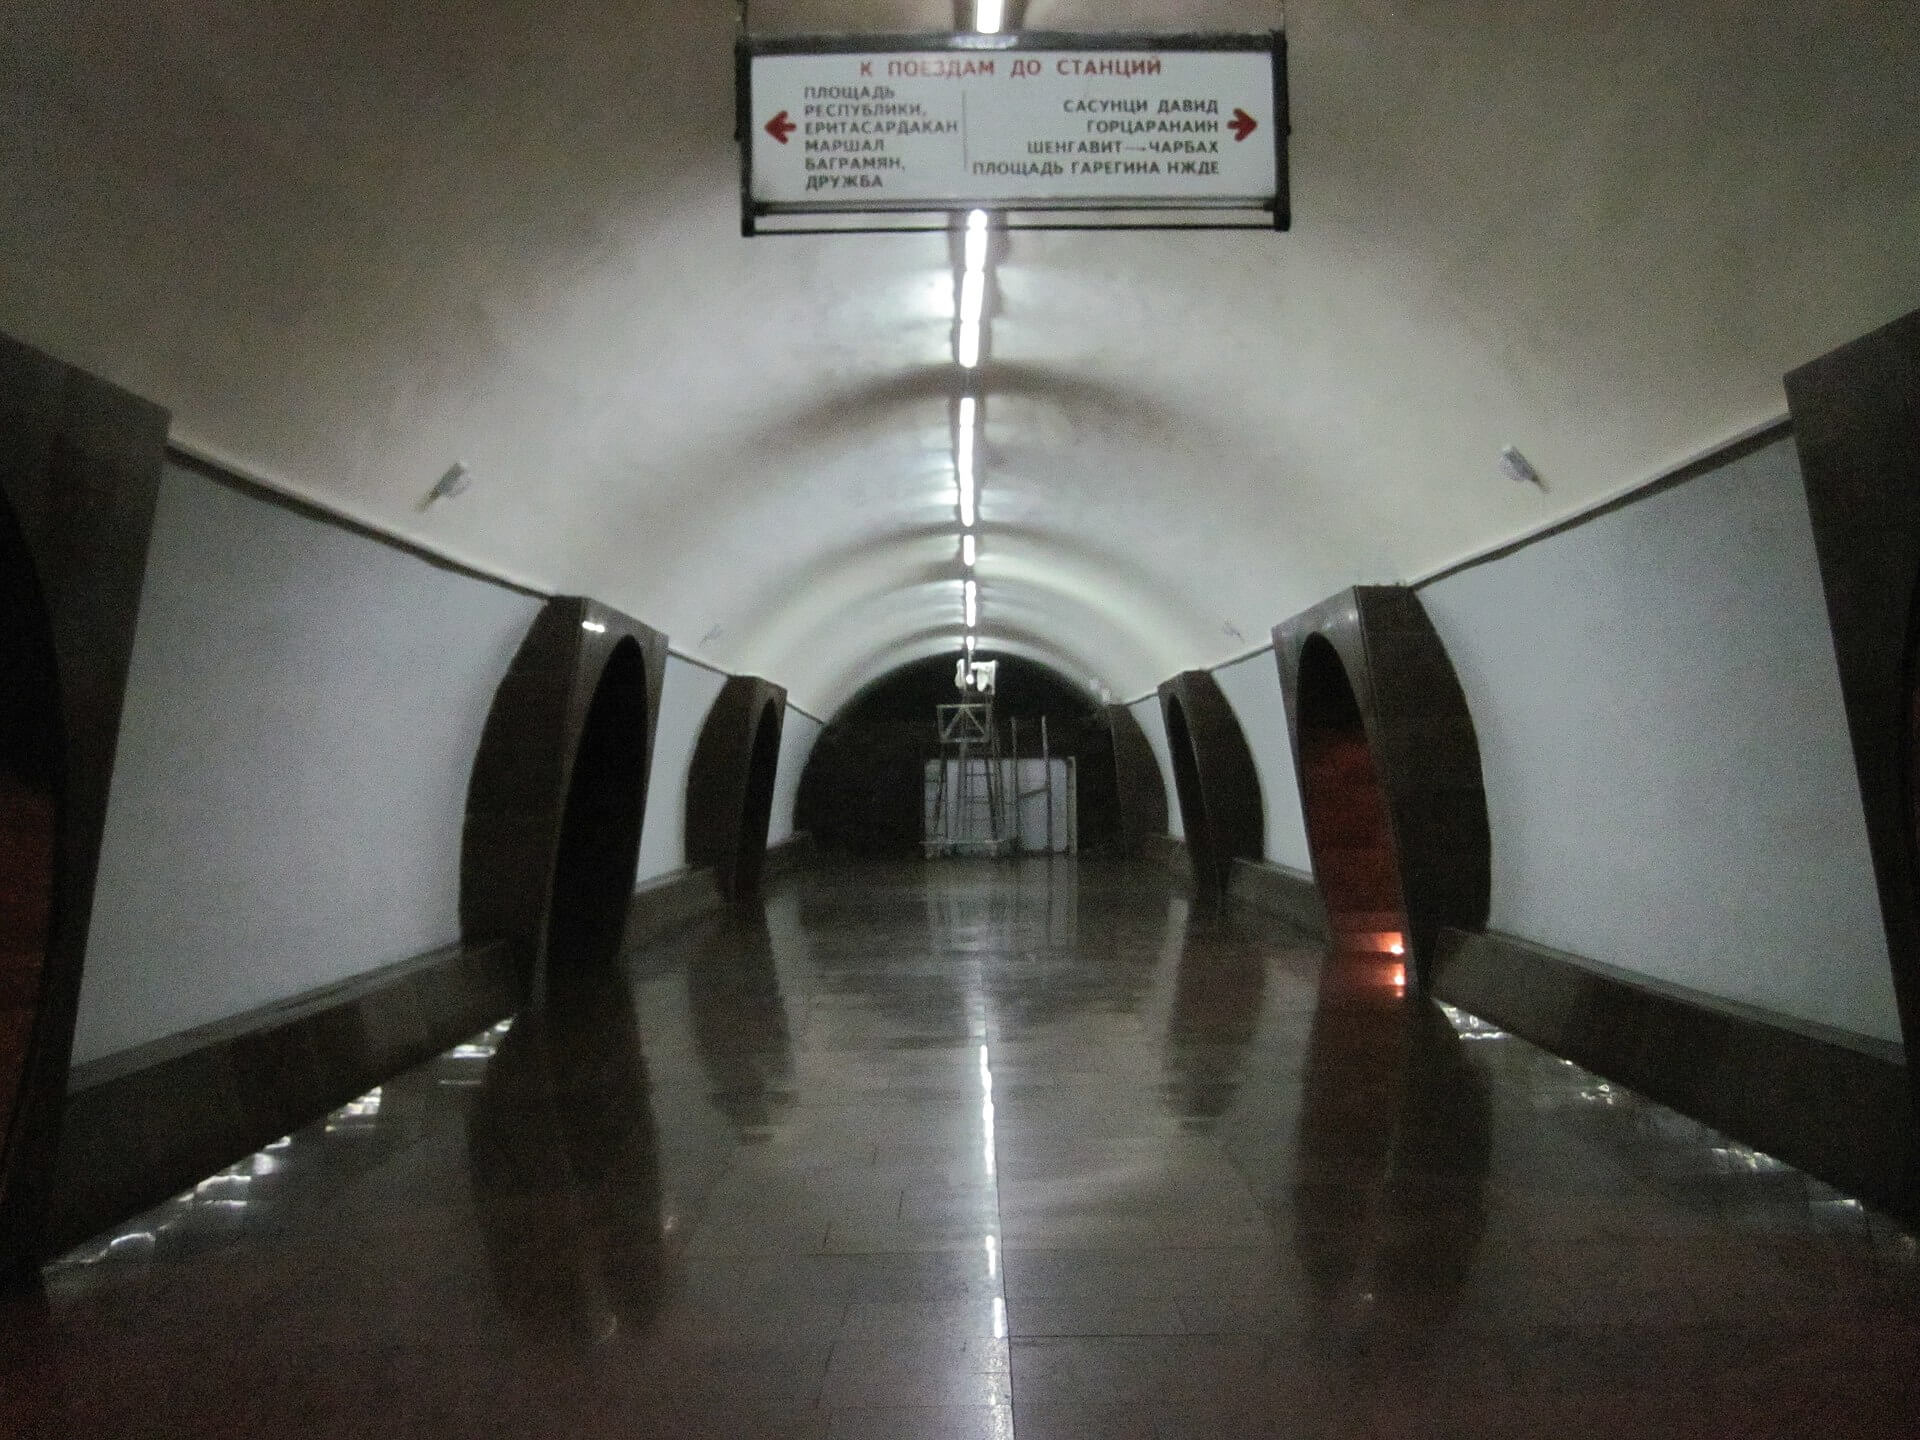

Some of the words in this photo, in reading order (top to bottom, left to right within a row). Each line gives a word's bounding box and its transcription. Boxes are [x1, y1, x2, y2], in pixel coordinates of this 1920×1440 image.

[860, 61, 873, 76] К
[888, 60, 996, 78] ПОЕЗДАМ
[1010, 60, 1041, 78] ДО
[1057, 56, 1162, 77] СТАНЦИЙ
[804, 86, 896, 101] ПЛОЩАДЬ
[804, 104, 927, 118] РЕСПУБЛИКИ,
[1063, 99, 1149, 114] САСУНЦИ
[1157, 99, 1219, 114] ДАВИД
[804, 121, 959, 136] ЕРИТАСАРДАКАН
[804, 139, 885, 152] МАРШАЛ
[804, 157, 906, 171] БАГРАМЯН,
[972, 161, 1064, 177] ПЛОЩАДЬ
[1071, 161, 1161, 176] ГАРЕГИНА
[1167, 161, 1220, 177] НЖДЕ
[804, 174, 884, 191] ДРУЖБА
